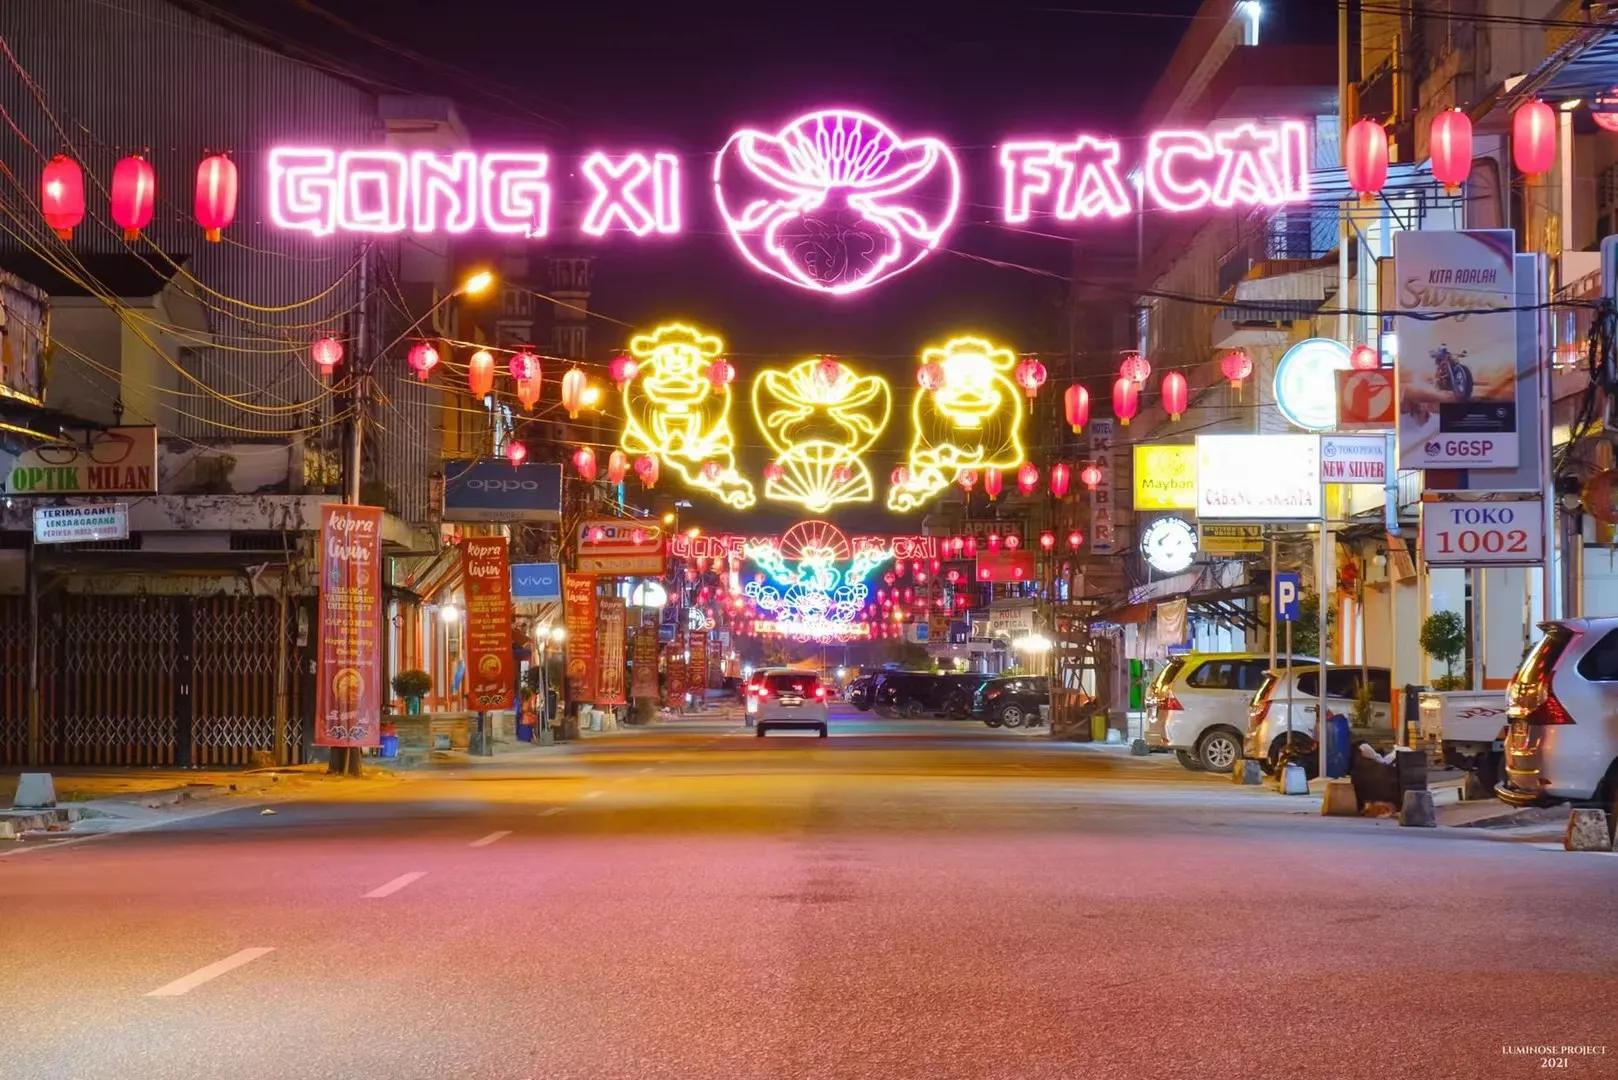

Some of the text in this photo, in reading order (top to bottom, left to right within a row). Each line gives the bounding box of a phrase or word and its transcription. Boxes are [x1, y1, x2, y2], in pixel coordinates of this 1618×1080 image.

[1000, 119, 1310, 224] FA CAI
[268, 147, 681, 238] GONG XI
[1428, 268, 1497, 284] KITA ADALAH
[1445, 440, 1494, 457] GGSP
[12, 465, 151, 491] OPTIK MILAN
[1322, 460, 1385, 478] NEW SILVER
[1141, 479, 1194, 491] Mayban
[43, 508, 82, 518] TERIMA
[1450, 508, 1514, 524] TOKO
[328, 510, 375, 537] kopra
[467, 541, 501, 559] kopra
[1435, 530, 1529, 553] 1002
[518, 575, 553, 586] vivo
[1279, 581, 1296, 615] P
